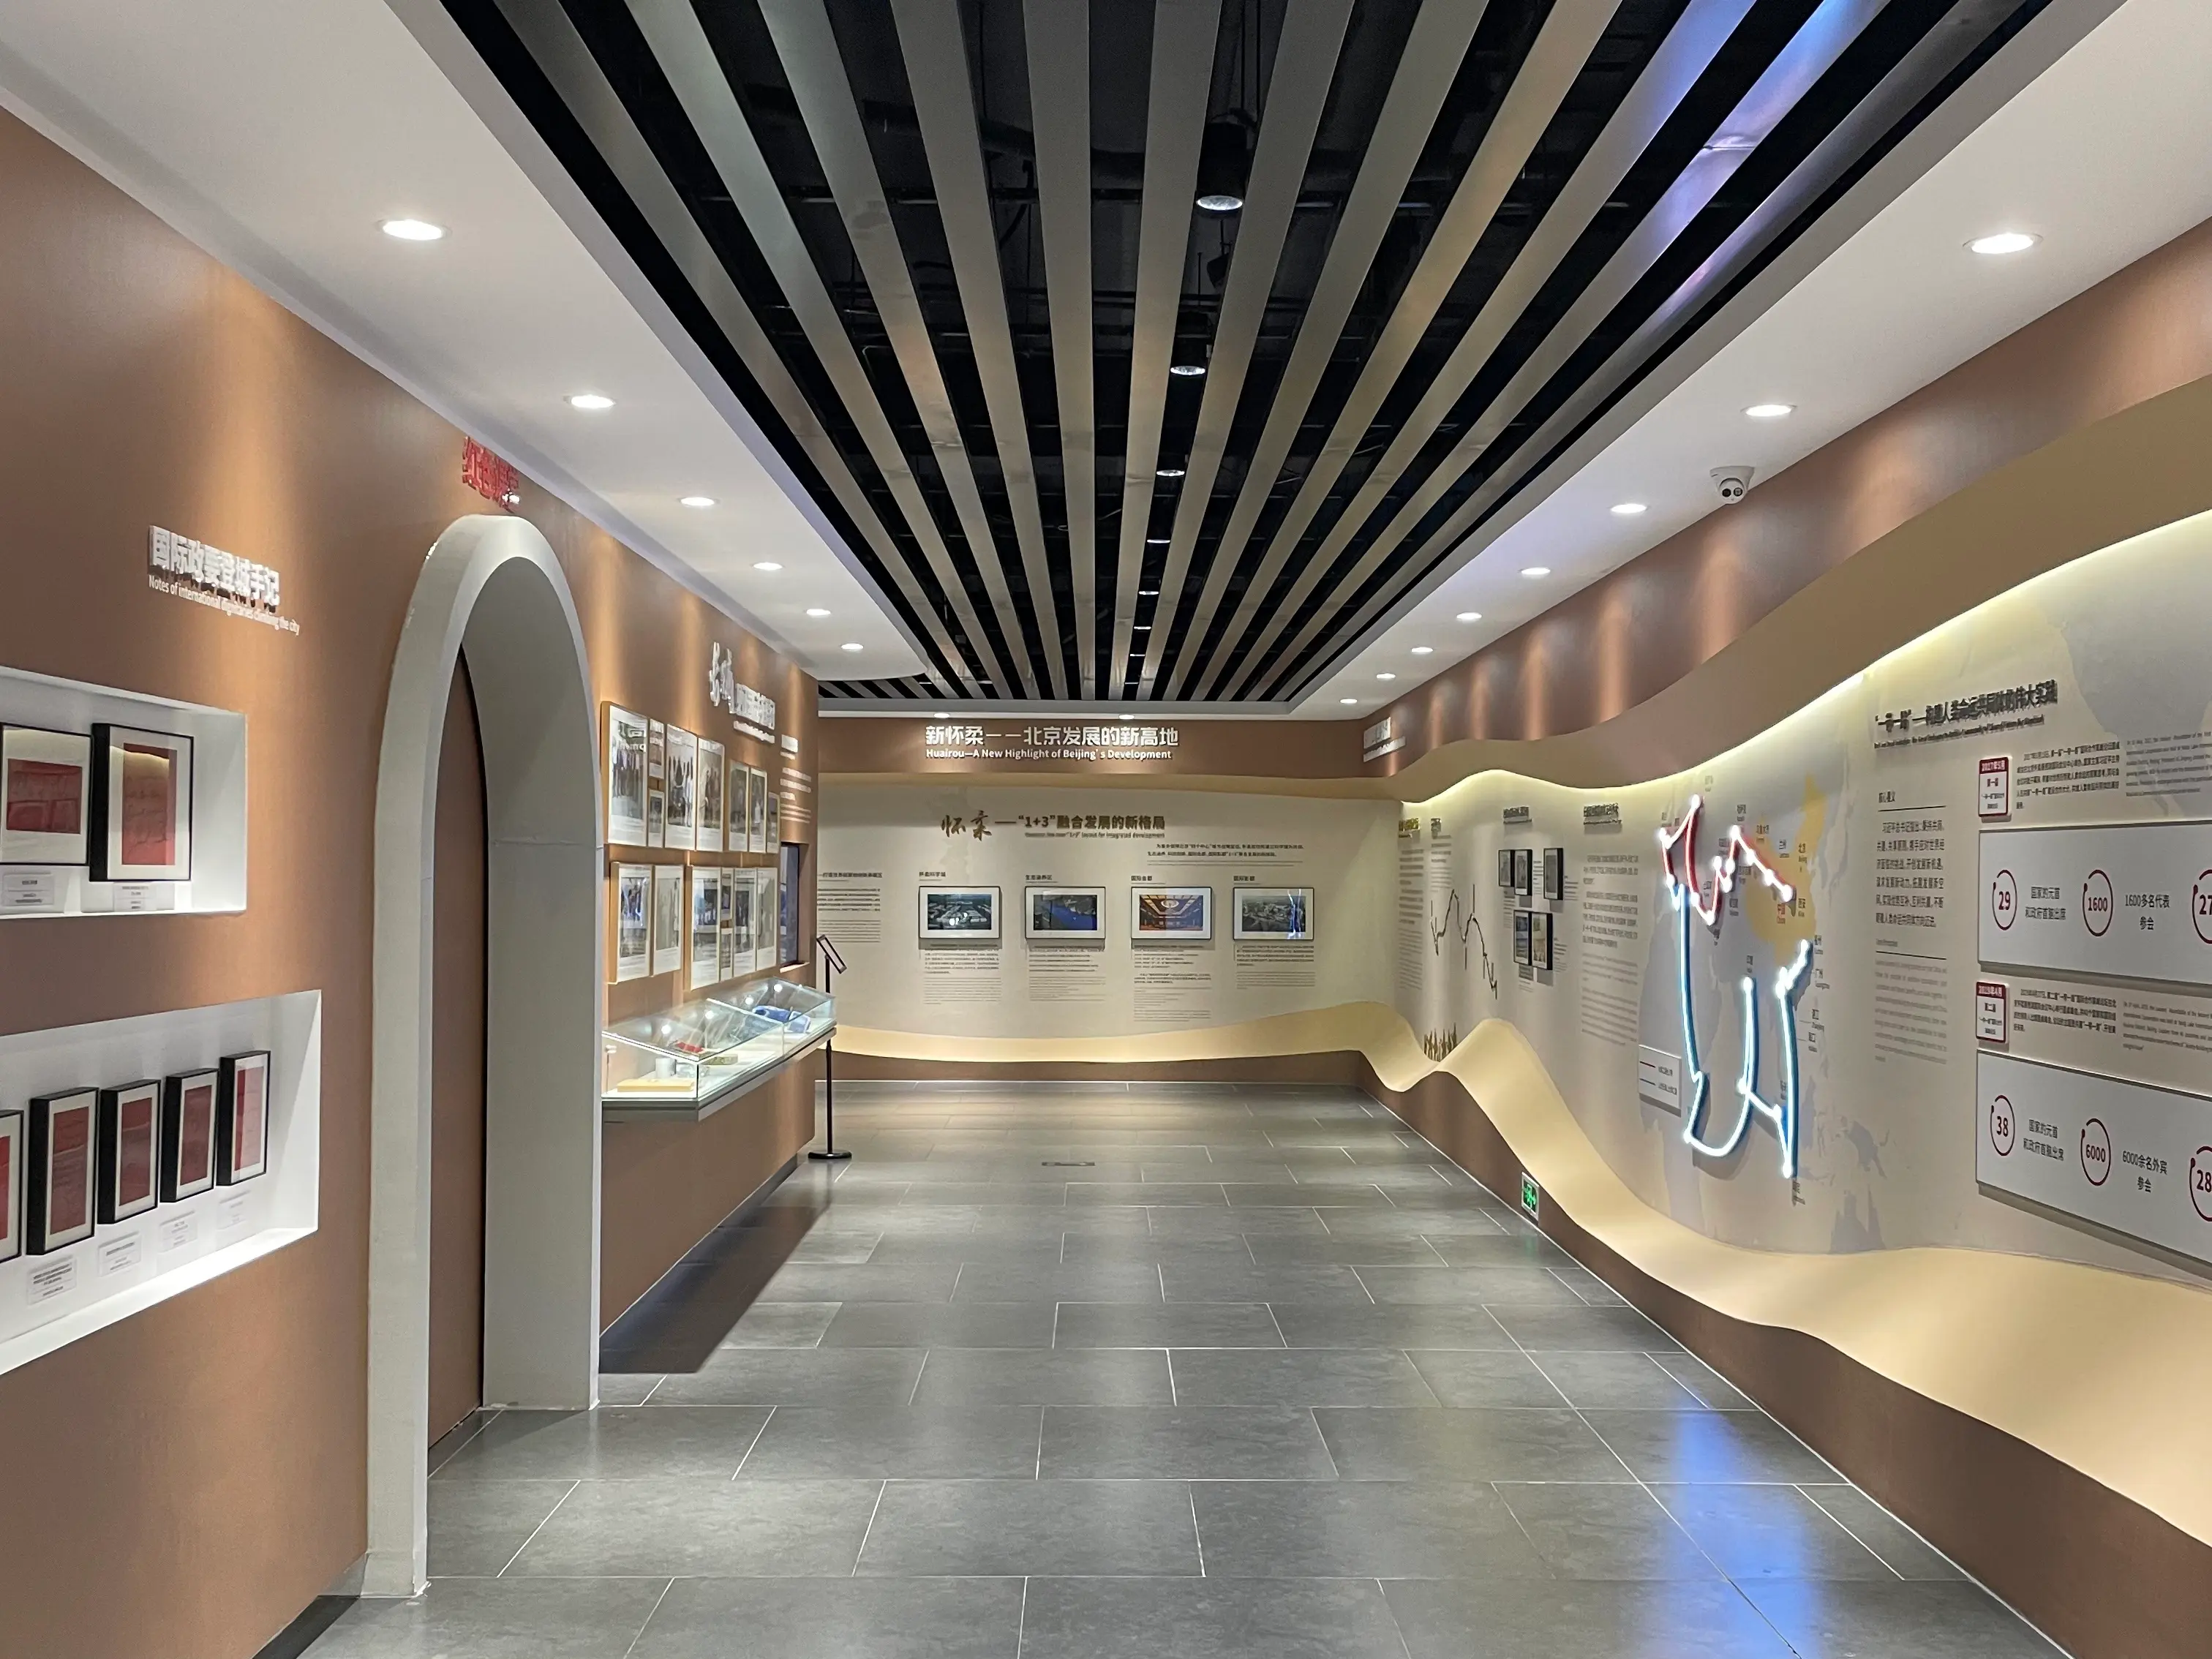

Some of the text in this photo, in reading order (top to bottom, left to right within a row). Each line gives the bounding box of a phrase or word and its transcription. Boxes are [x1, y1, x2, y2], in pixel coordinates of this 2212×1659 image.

[148, 575, 169, 593] Notes
[170, 582, 178, 594] of
[178, 584, 220, 609] international
[290, 620, 300, 636] city
[925, 726, 1178, 746] 新怀柔——北京发展的新高地
[982, 750, 1002, 759] New
[1005, 749, 1050, 761] Highlight
[1051, 749, 1061, 759] of
[1107, 749, 1171, 761] Development
[1998, 891, 2010, 911] 29
[2088, 897, 2108, 911] 1600
[2124, 894, 2170, 908] 1600多名代表
[2140, 916, 2154, 930] 参会
[1996, 1116, 2009, 1137] 38
[2085, 1143, 2106, 1163] 6000
[2122, 1150, 2167, 1175] 6000余名外宾
[2137, 1175, 2151, 1193] 参会
